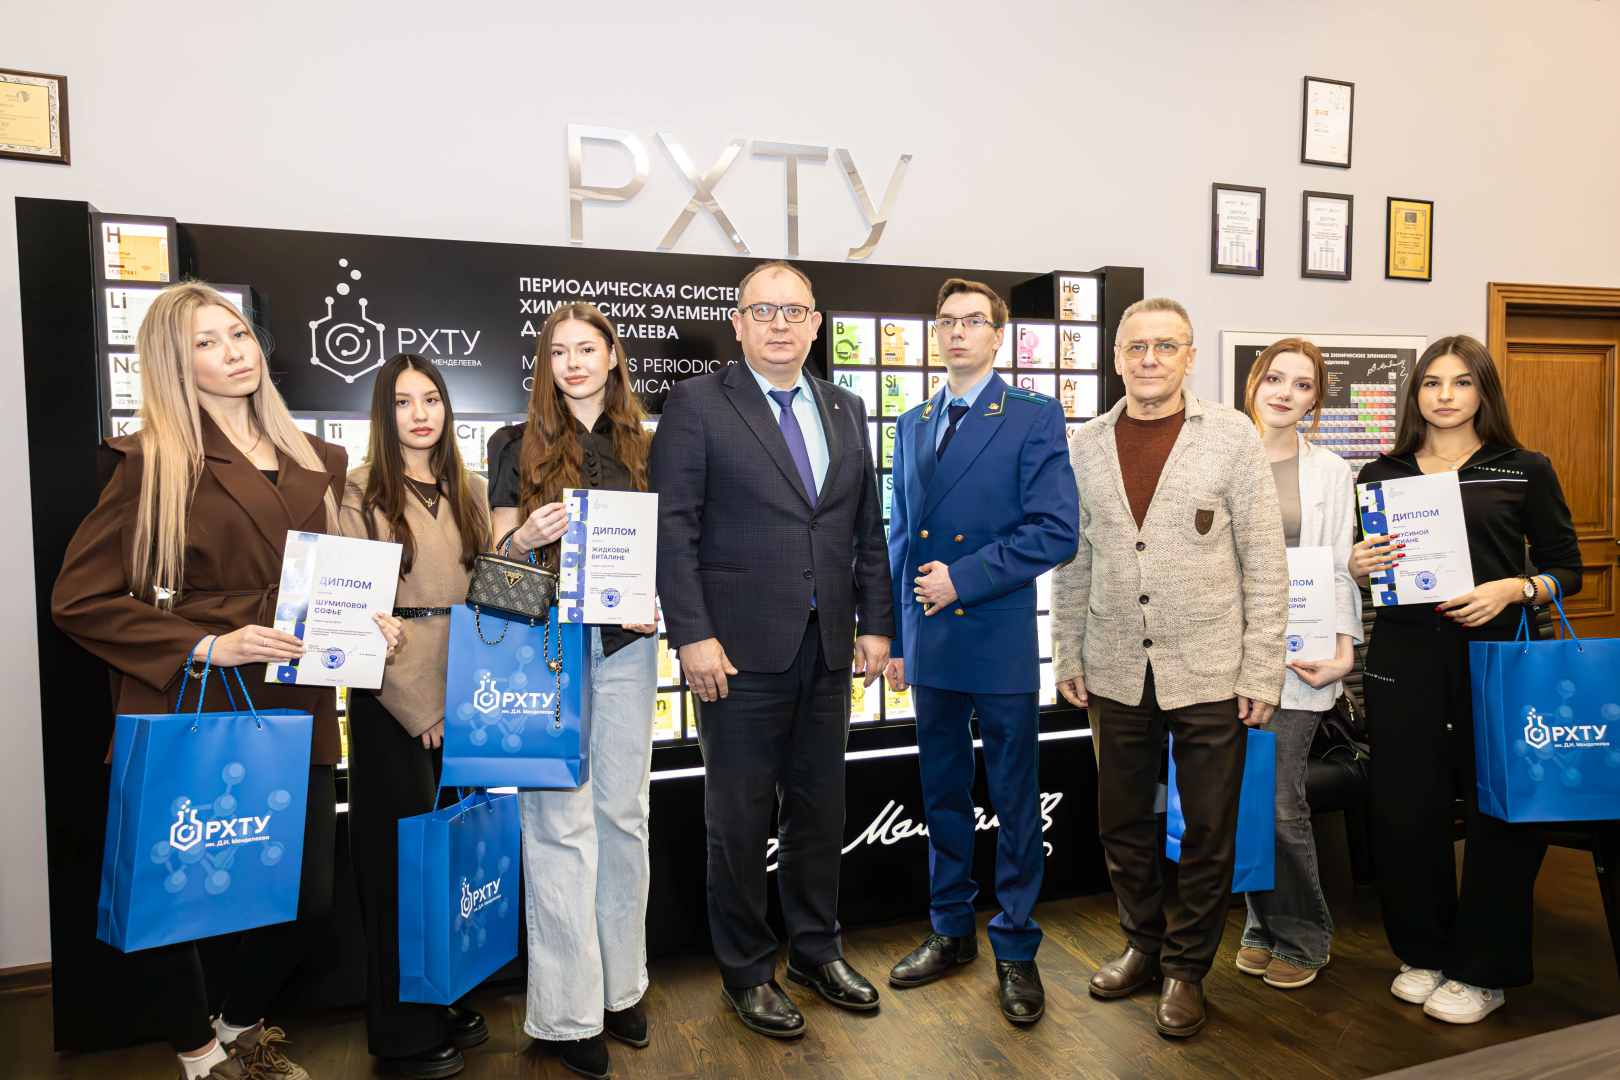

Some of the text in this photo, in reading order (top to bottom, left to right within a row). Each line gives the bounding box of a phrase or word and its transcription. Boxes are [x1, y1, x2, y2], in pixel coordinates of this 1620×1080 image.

[567, 123, 913, 261] РХТУ
[106, 226, 121, 243] H
[519, 277, 739, 301] ПЕРИОДИЧЕСКАЯ СИСТЕ
[1062, 280, 1080, 293] He
[110, 291, 127, 309] Li
[519, 299, 738, 321] ХИМСКИХ ЭЛЕМЕНТО
[616, 323, 679, 339] ЕЛЕЕВА
[836, 322, 844, 335] B
[884, 323, 896, 336] C
[1020, 328, 1026, 340] F
[397, 327, 481, 356] РХТУ
[1063, 330, 1081, 342] Ne
[431, 358, 482, 367] МЕНДЕЛЕЕВА
[643, 358, 721, 373] PERIODIC
[838, 374, 852, 387] Al
[885, 375, 896, 388] Si
[931, 376, 939, 388] P
[1020, 377, 1034, 390] Cl
[1063, 378, 1077, 391] Ar
[117, 421, 130, 436] K
[328, 423, 342, 439] Ti
[456, 424, 477, 439] Cr
[1392, 508, 1440, 522] ДИПЛОМ
[592, 526, 636, 536] ДИПЛОМ
[318, 576, 372, 590] ДИПЛОМ
[314, 607, 342, 615] СОФЬЕ
[315, 599, 367, 609] ШУМИЛОВОЙ
[502, 692, 556, 708] РХТУ
[1551, 724, 1607, 741] РХТУ
[205, 815, 271, 840] РХТУ
[231, 835, 270, 844] Менделеева
[473, 877, 501, 906] РХТУ
